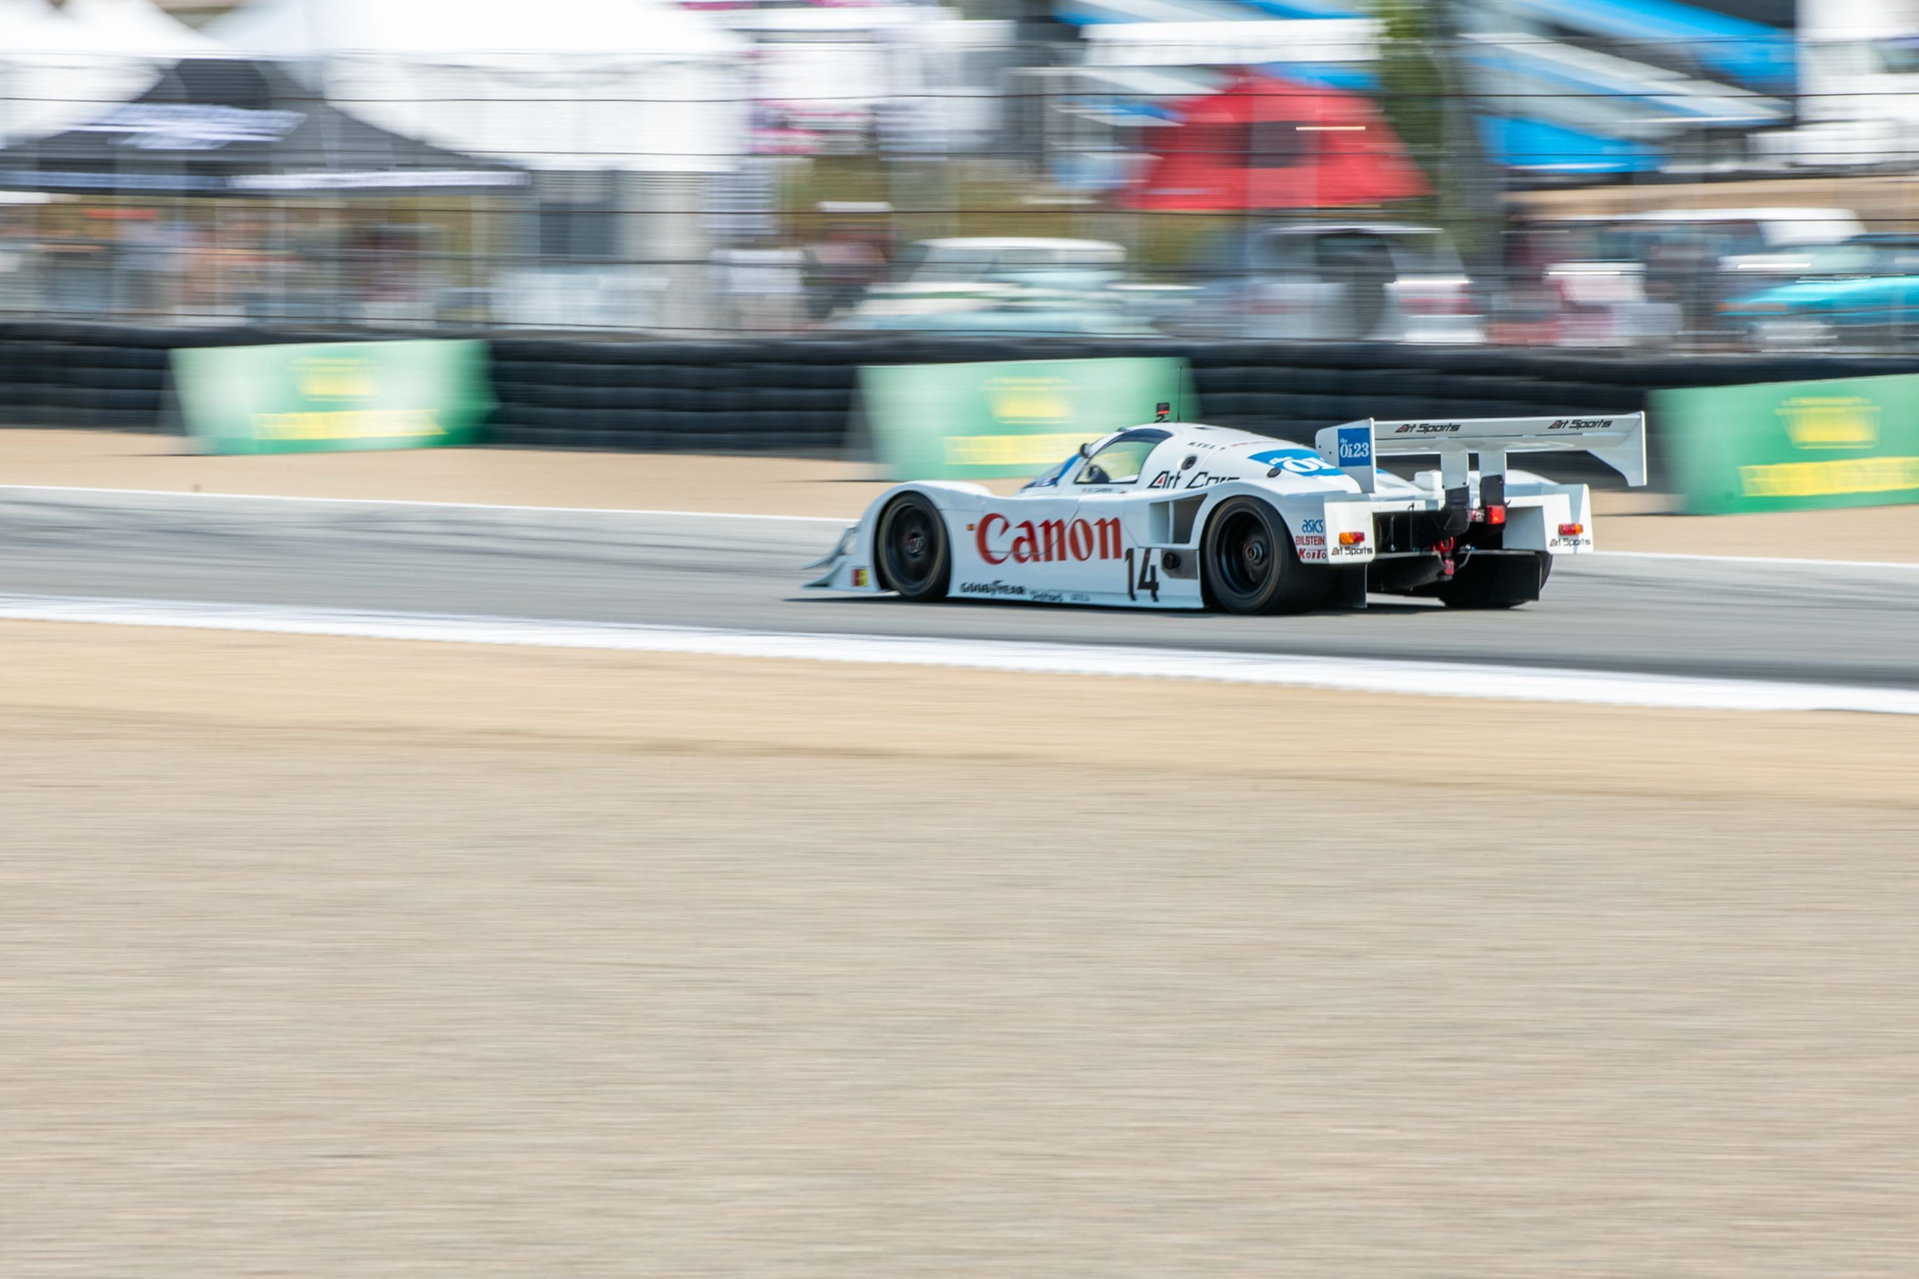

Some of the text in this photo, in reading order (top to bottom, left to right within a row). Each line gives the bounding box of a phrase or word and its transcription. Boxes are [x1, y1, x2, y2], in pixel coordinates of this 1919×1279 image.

[1395, 423, 1461, 434] Art Sports
[1547, 419, 1613, 430] Art Sports
[1147, 470, 1181, 489] Art
[975, 513, 1123, 565] Canon
[1295, 535, 1325, 546] BILSTEIN
[1562, 537, 1591, 547] Sports
[1344, 546, 1373, 556] Sports
[1125, 548, 1160, 602] 14
